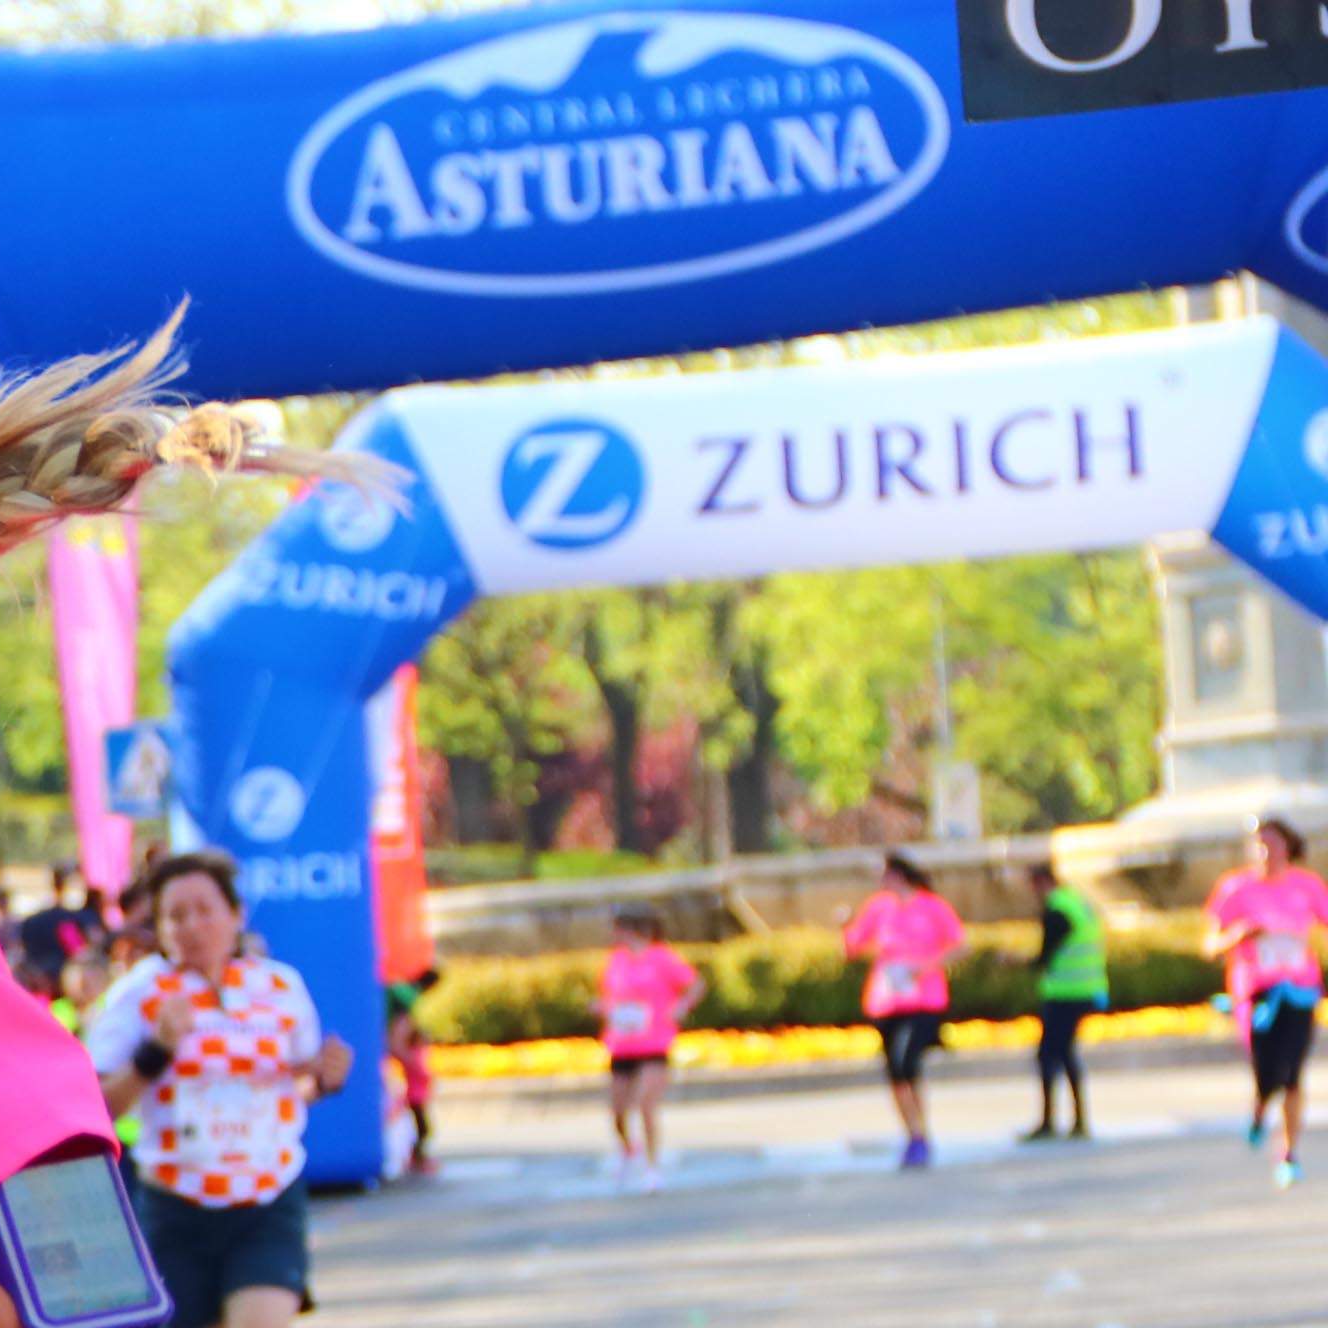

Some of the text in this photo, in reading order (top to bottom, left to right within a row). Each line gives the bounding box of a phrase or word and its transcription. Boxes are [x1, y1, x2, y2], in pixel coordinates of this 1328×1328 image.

[432, 66, 872, 143] CENTRAL LECHERA
[343, 105, 903, 242] ASTURIANA
[694, 403, 1144, 518] ZURICH
[234, 850, 362, 900] RICH
